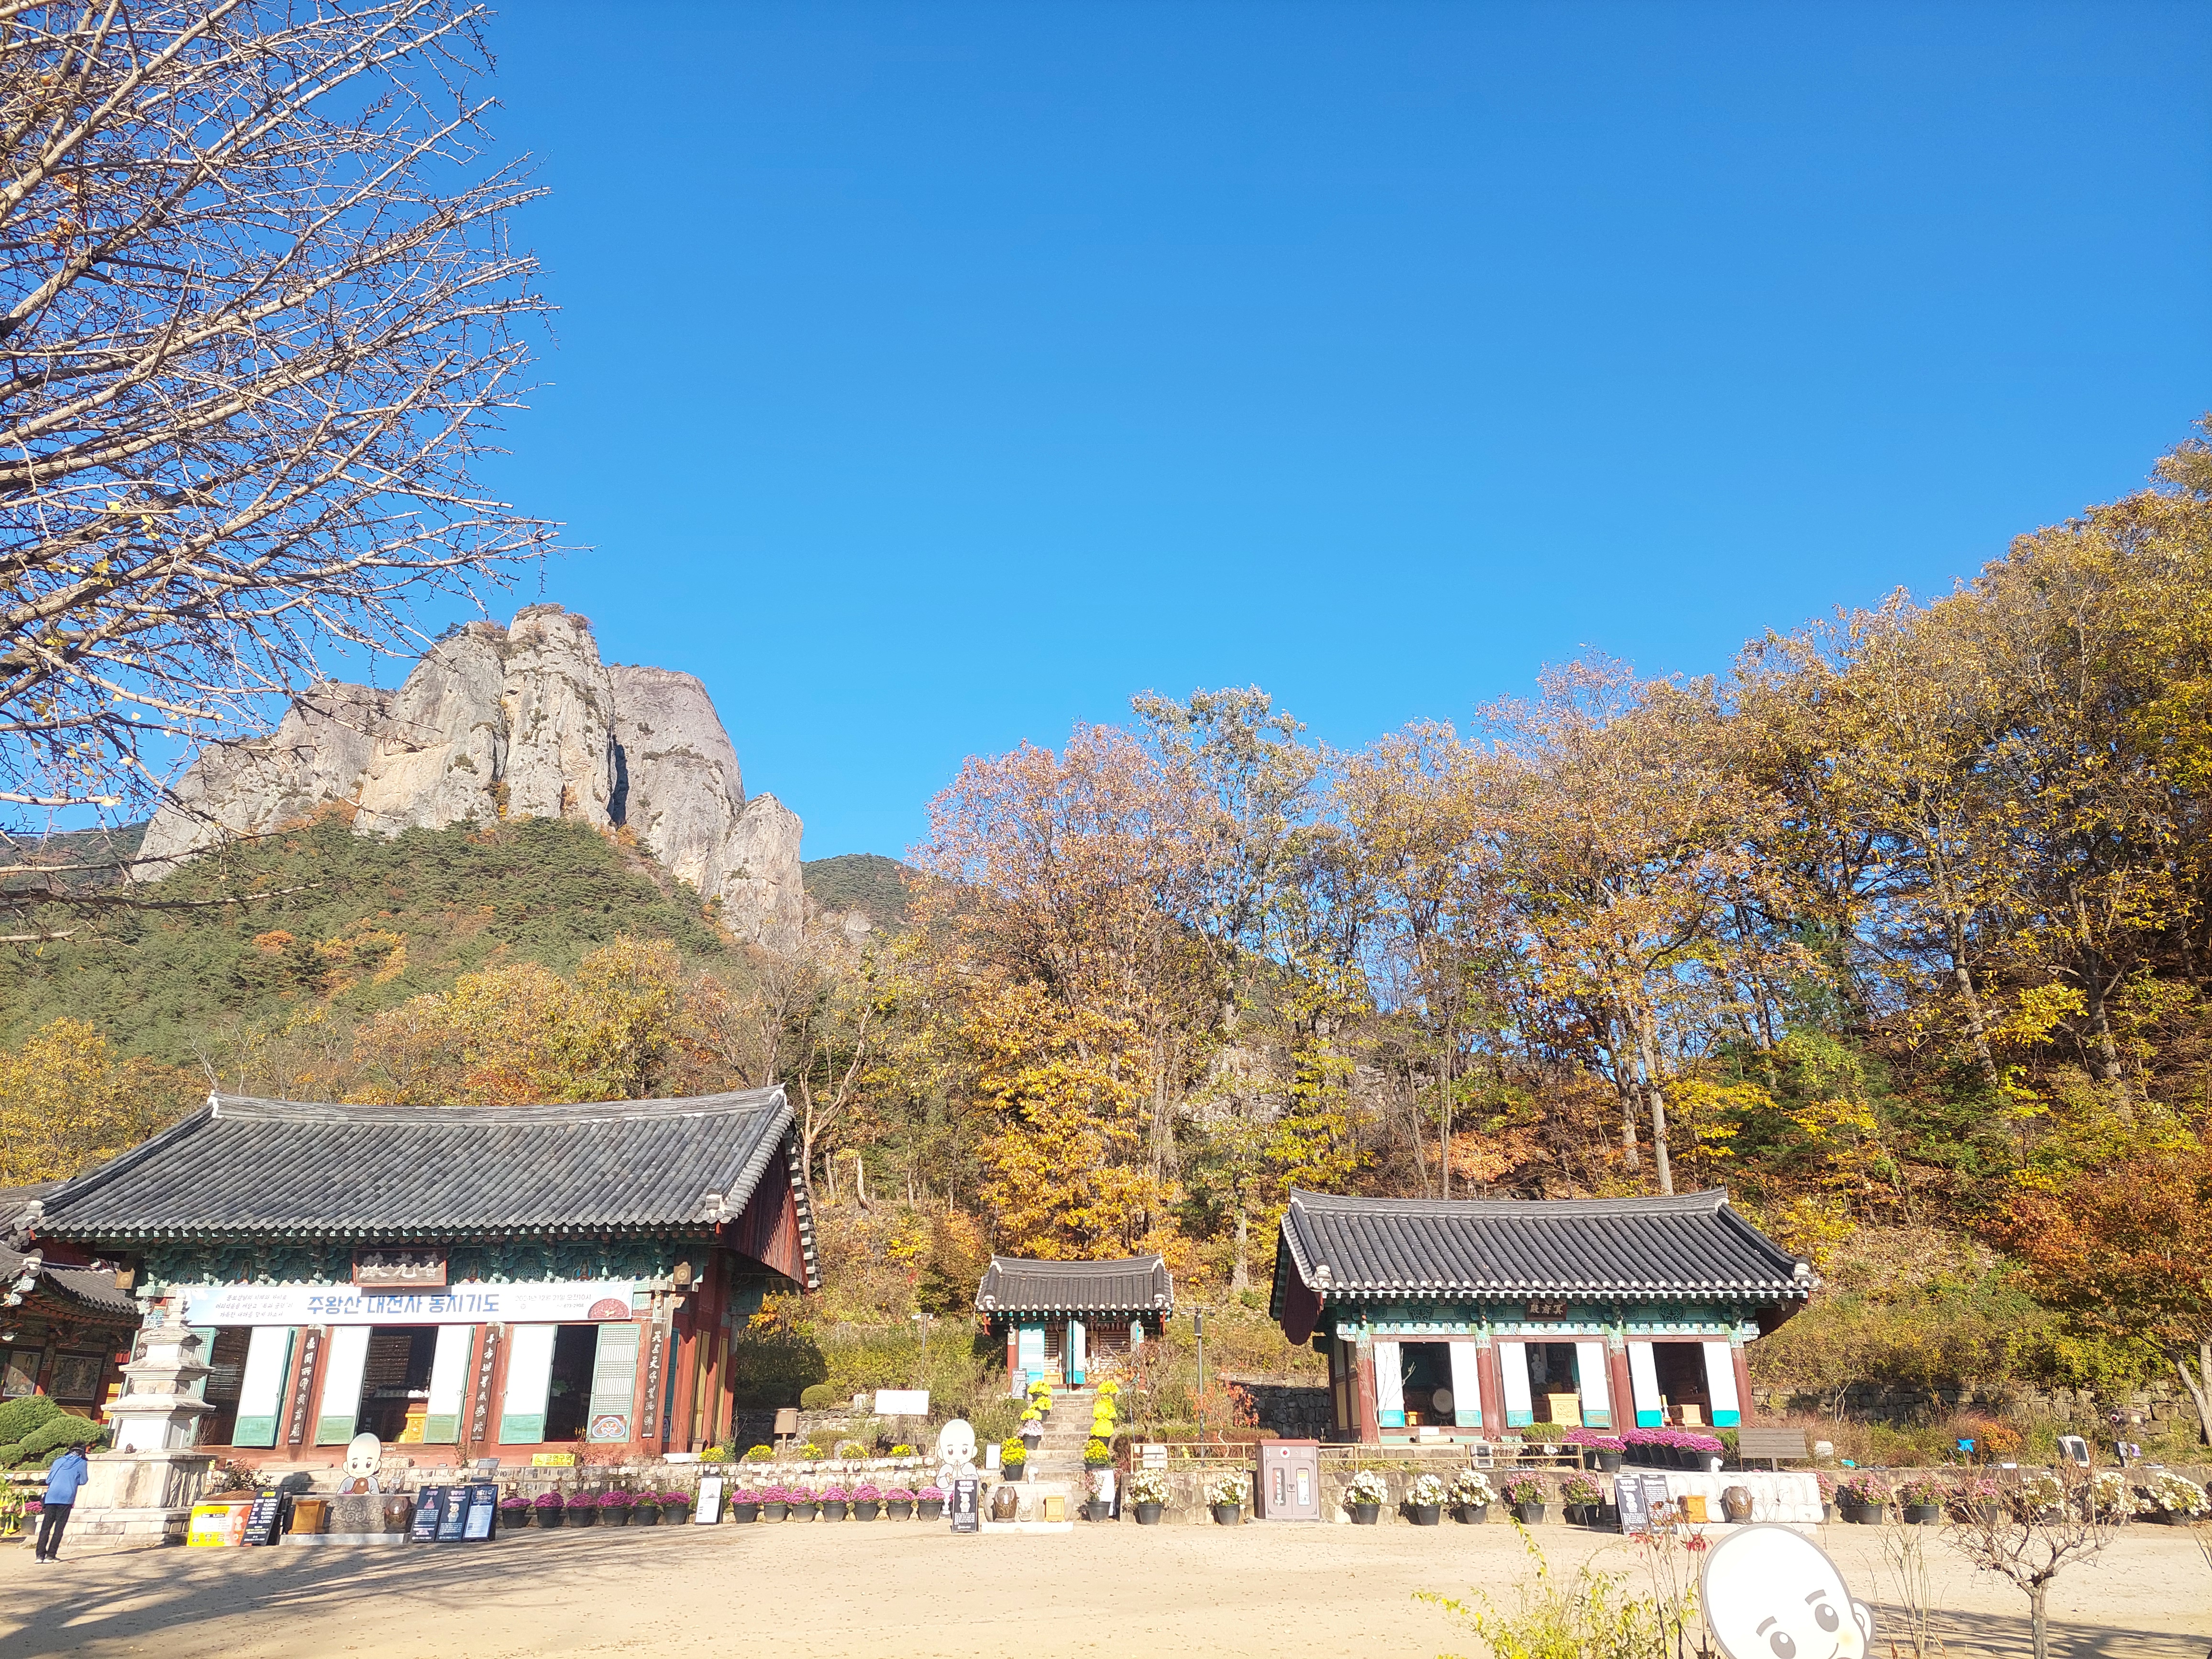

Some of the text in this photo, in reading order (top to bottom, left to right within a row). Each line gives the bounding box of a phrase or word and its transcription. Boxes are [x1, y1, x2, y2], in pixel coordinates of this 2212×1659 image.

[308, 1294, 499, 1315] 주왕산 대전사 동지기도
